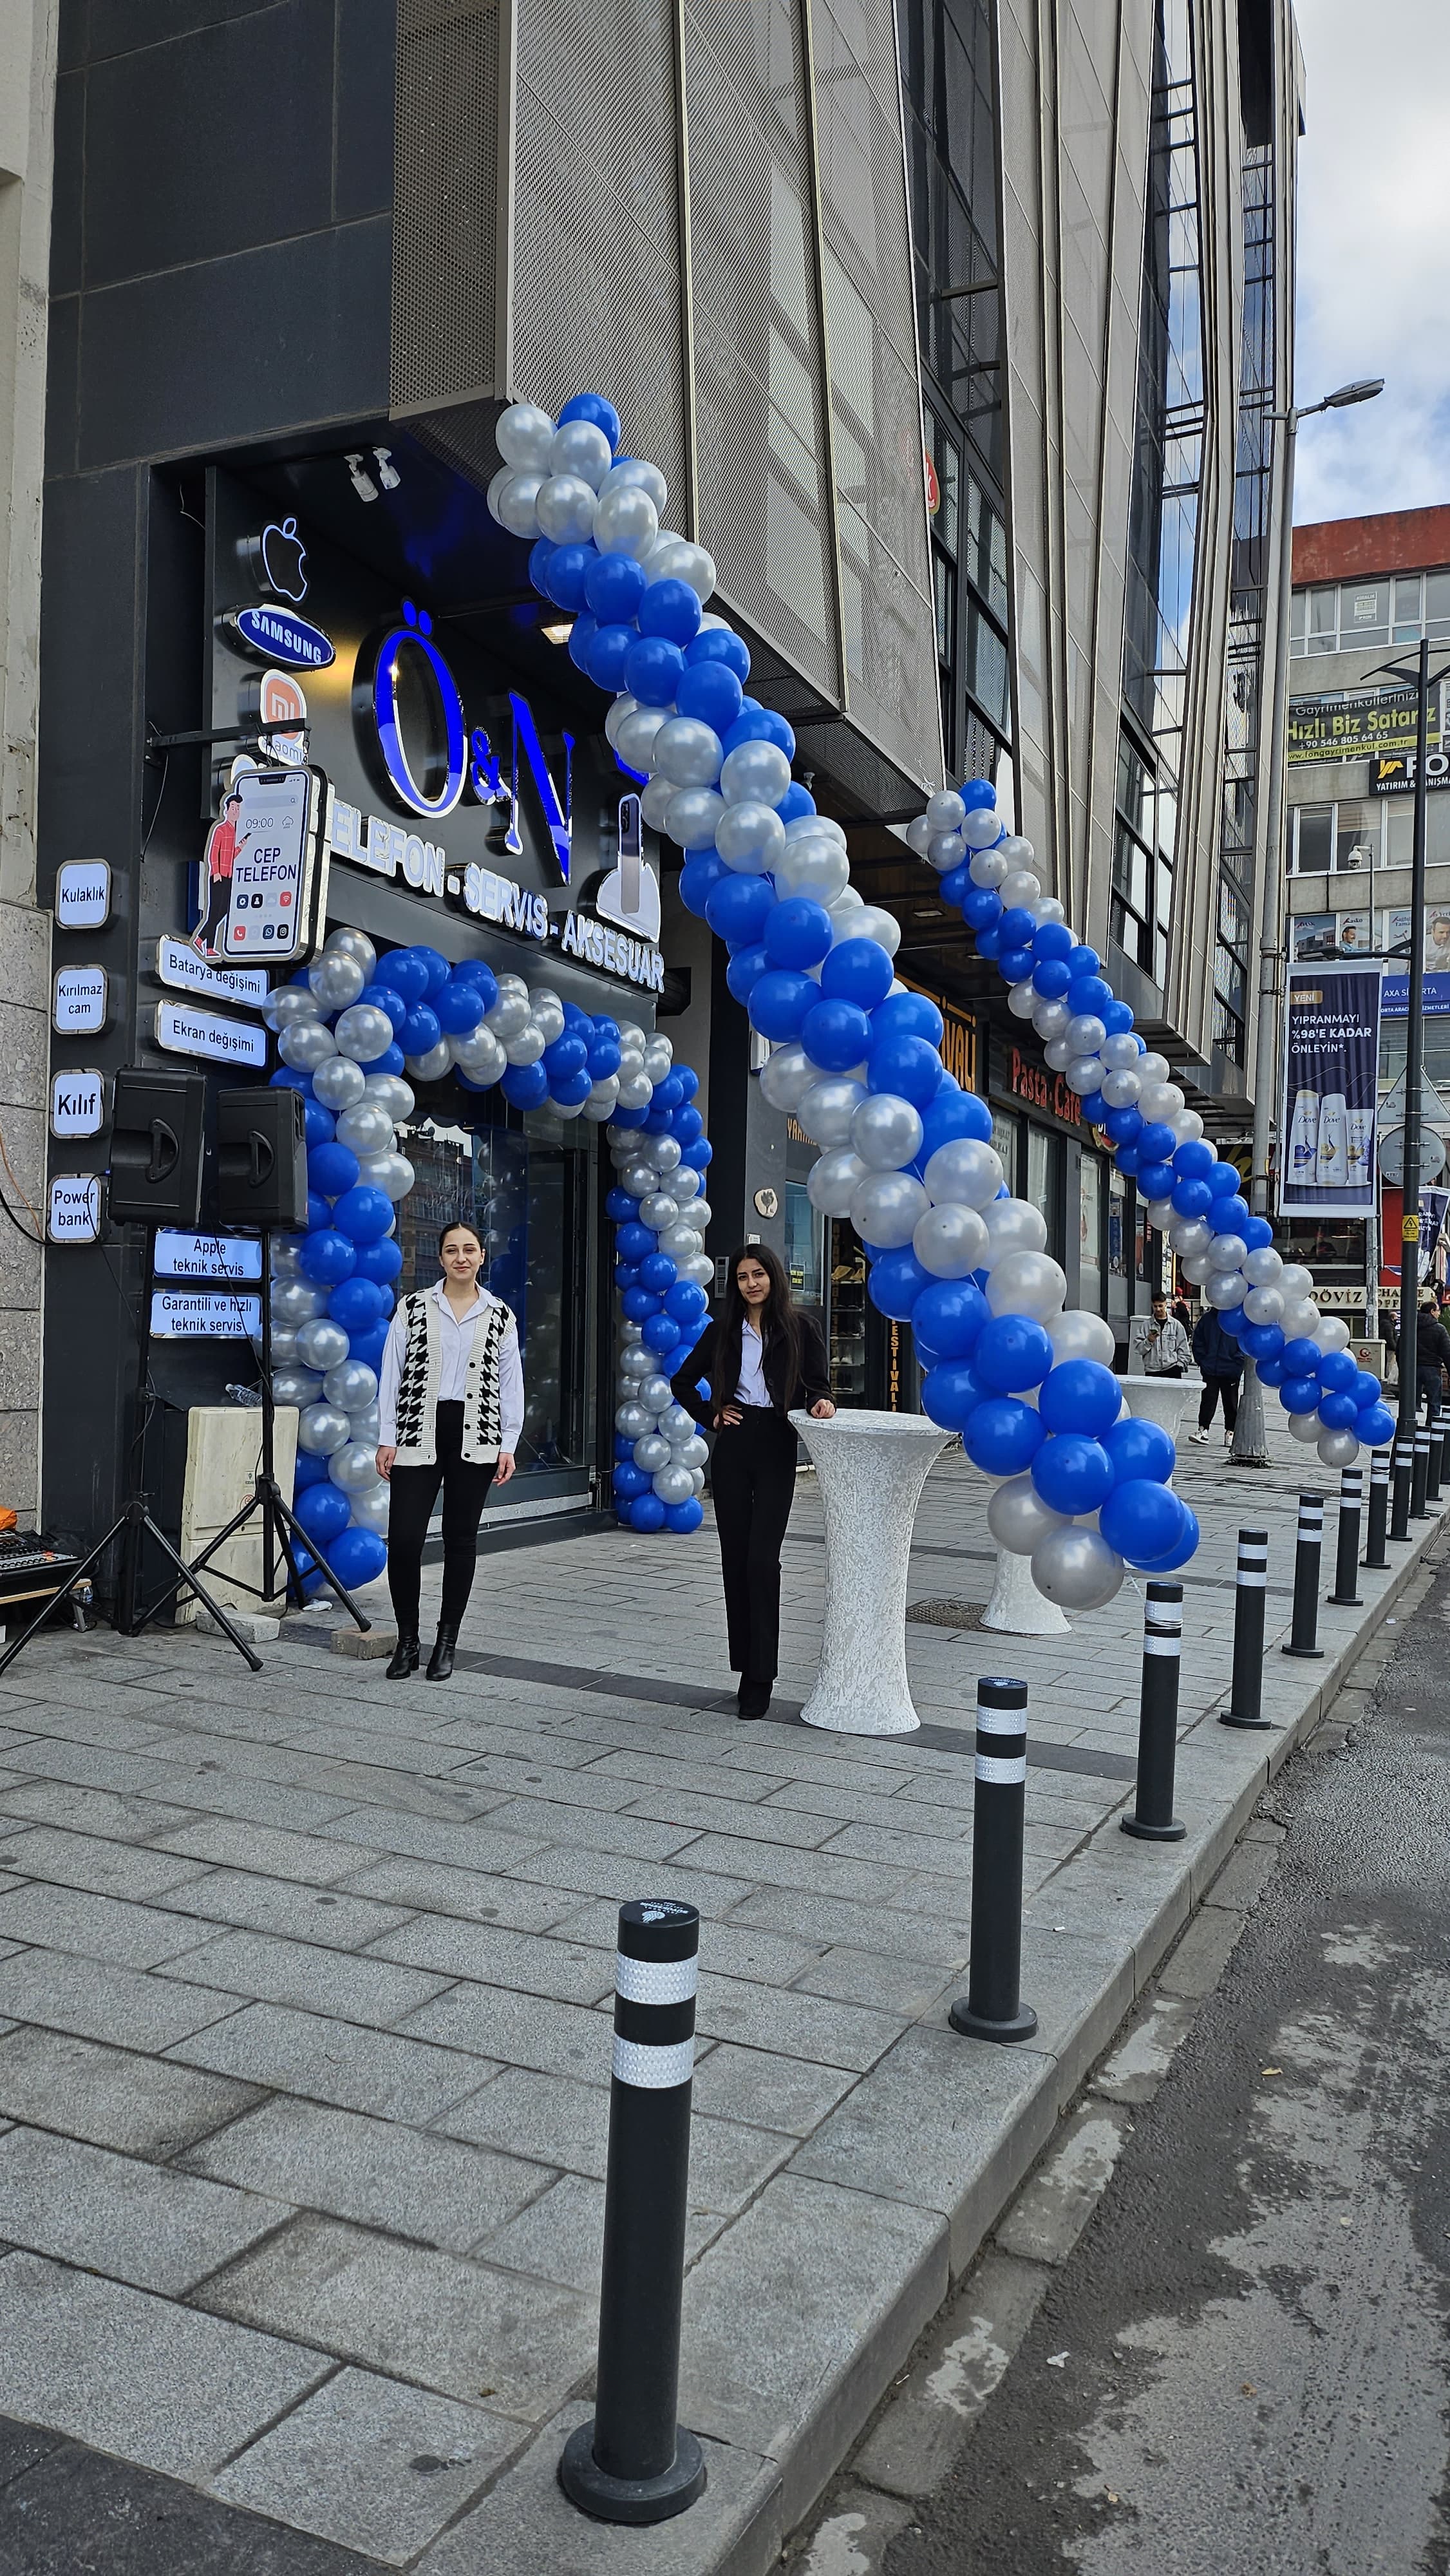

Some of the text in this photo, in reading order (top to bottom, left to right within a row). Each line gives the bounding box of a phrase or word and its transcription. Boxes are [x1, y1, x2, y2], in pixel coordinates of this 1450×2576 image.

[252, 611, 321, 663] SAMSUNG
[1333, 714, 1361, 736] Biz
[1368, 708, 1436, 732] Satarz
[1299, 731, 1388, 750] +90 546 805 64 65
[1288, 739, 1408, 760] ww.fongayrimenkul.com.tr
[1377, 781, 1408, 791] YATIRIM
[1409, 780, 1416, 788] &
[246, 817, 274, 829] 09:00
[254, 848, 281, 864] CEP
[236, 864, 296, 883] TELEFON
[62, 886, 105, 904] Kulaklık
[330, 799, 445, 897] ELEFON
[464, 862, 548, 940] SERVIS
[561, 909, 664, 994] AKSESUAR
[169, 953, 212, 980] Batarya
[59, 983, 102, 998] Kırılmaz
[1294, 994, 1314, 1002] YENİ
[68, 1003, 91, 1014] cam
[1292, 1014, 1359, 1025] YIPRANMAYI
[173, 1019, 205, 1041] Ekran
[1292, 1027, 1372, 1039] %98'E KADAR
[1012, 1047, 1047, 1108] Pasta
[58, 1093, 97, 1116] Kılıf
[1298, 1115, 1317, 1124] Dove
[1323, 1115, 1340, 1124] Dove
[54, 1189, 95, 1205] Power
[58, 1211, 90, 1226] bank
[194, 1238, 226, 1256] Apple
[173, 1258, 244, 1276] teknik servis
[162, 1296, 211, 1311] Garantili
[214, 1302, 226, 1311] ve
[1308, 1289, 1362, 1303] DÖVİZ
[171, 1317, 242, 1332] teknik servis
[890, 1319, 899, 1412] ESTİVALİ
